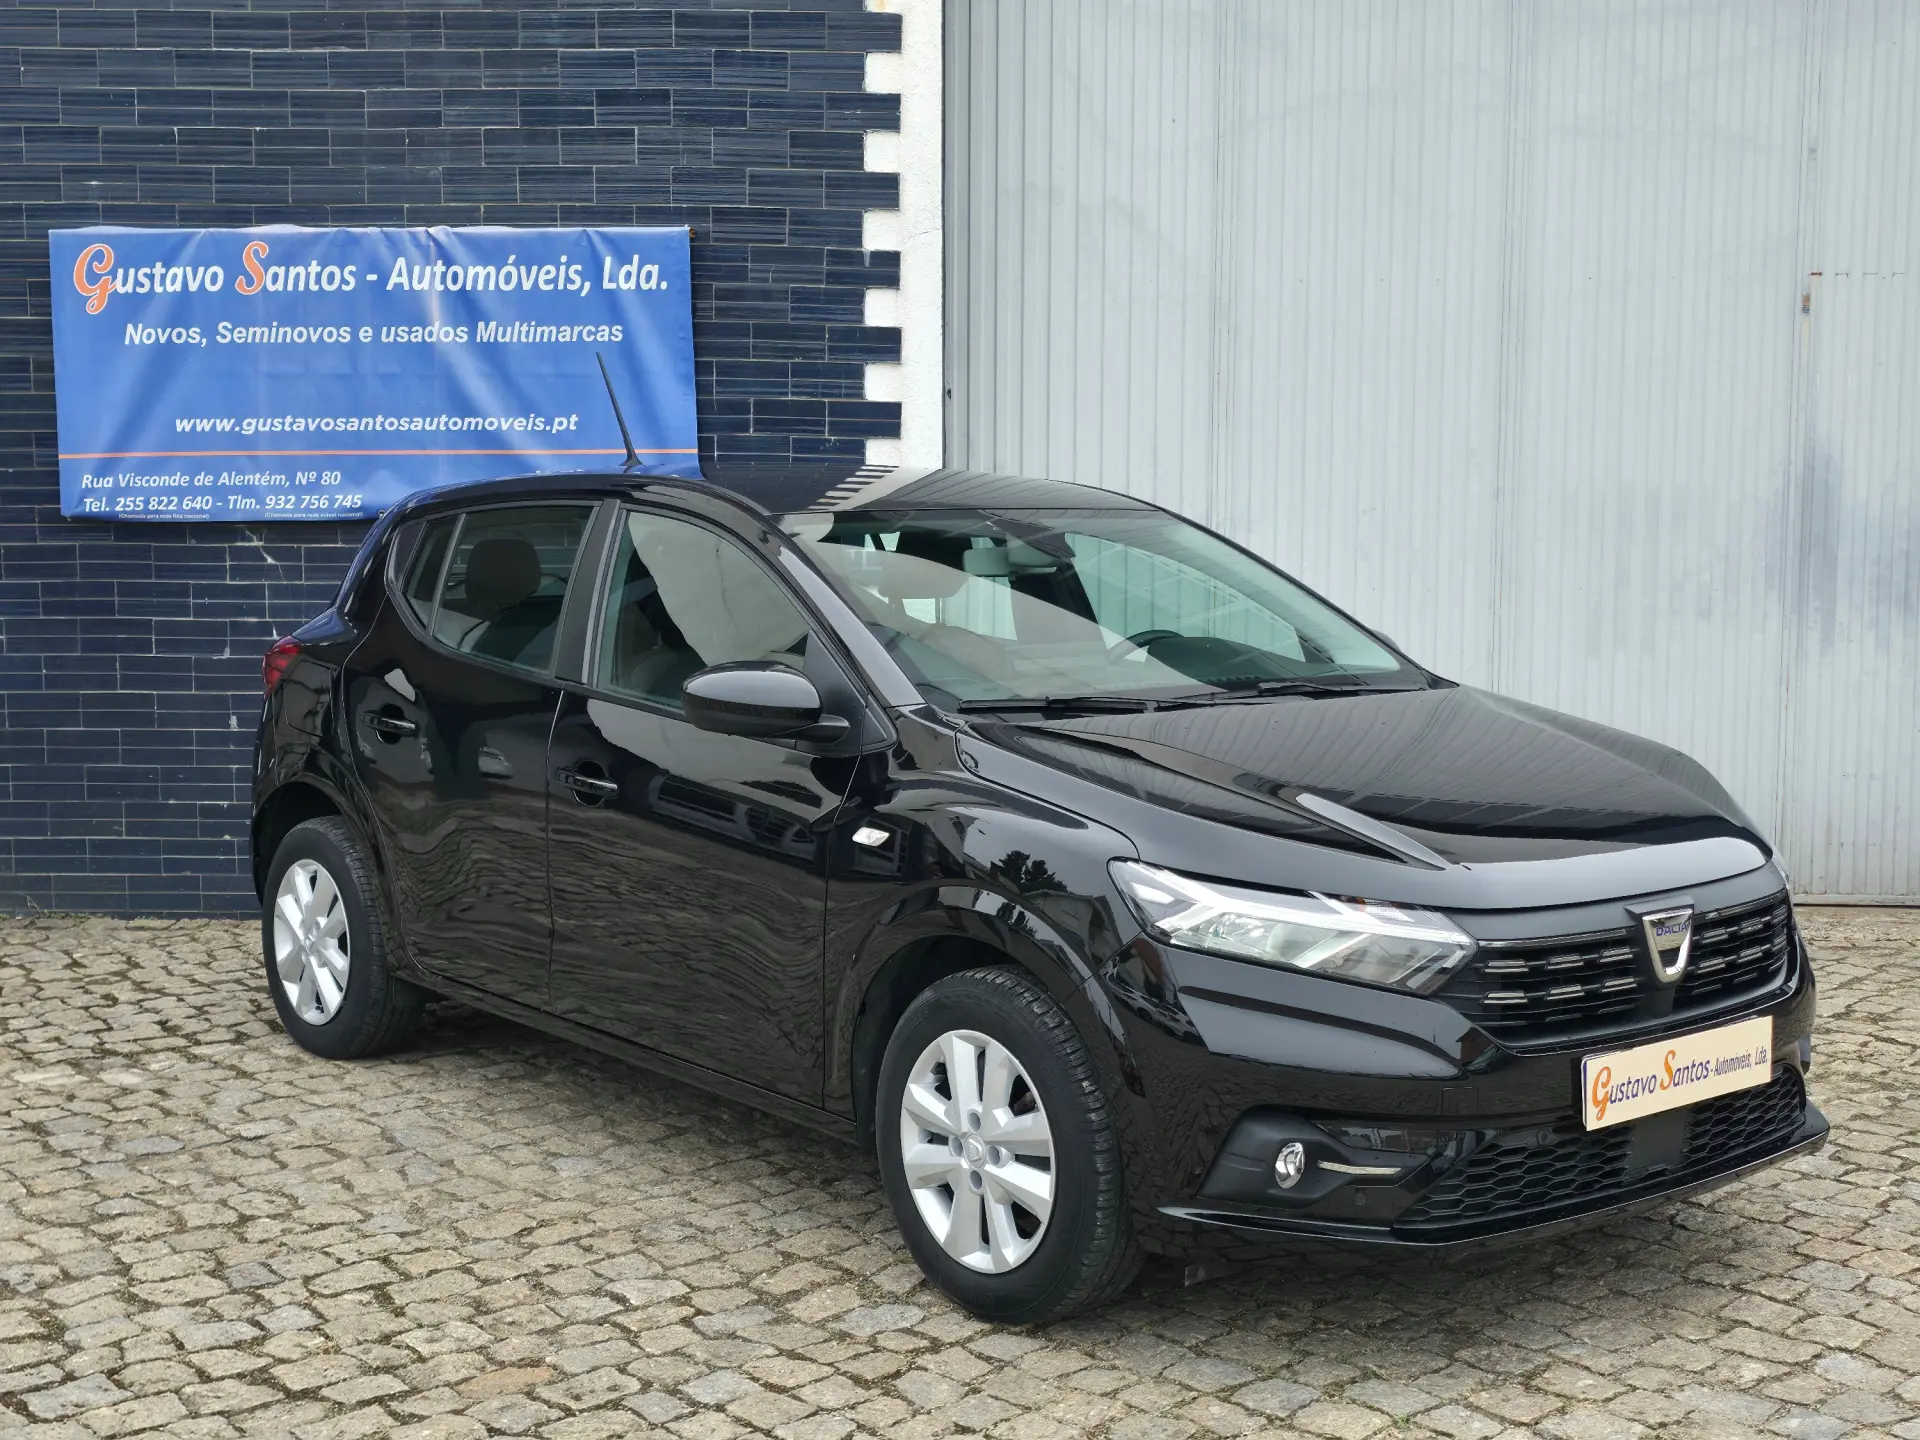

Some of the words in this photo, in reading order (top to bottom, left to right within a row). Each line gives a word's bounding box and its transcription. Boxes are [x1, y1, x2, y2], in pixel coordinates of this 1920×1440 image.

[73, 243, 224, 314] Gustavo
[235, 241, 357, 294] Santos
[386, 254, 591, 296] Automóveis,
[602, 254, 668, 290] Lda.
[124, 323, 207, 347] Novos,
[216, 321, 351, 343] Seminovos
[358, 326, 373, 342] e
[381, 321, 468, 342] usados
[476, 321, 623, 342] Multimarcas
[175, 414, 579, 435] www.gustavosantosautomoveis.pt
[81, 474, 113, 489] Rua
[118, 471, 189, 487] Visconde
[193, 471, 214, 486] de
[217, 470, 290, 488] Alentém,
[295, 471, 317, 486] Nº
[320, 471, 341, 486] 80
[83, 497, 110, 512] Tel.
[114, 496, 145, 511] 255
[148, 495, 178, 511] 822
[182, 495, 213, 510] 640
[227, 495, 260, 510] Tlm.
[265, 495, 296, 509] 932
[300, 495, 329, 509] 756
[333, 494, 363, 509] 745
[1655, 922, 1688, 937] DACIA
[1592, 1066, 1657, 1121] Gustavo
[1659, 1049, 1710, 1091] Santos
[1755, 1045, 1768, 1066] Lda.
